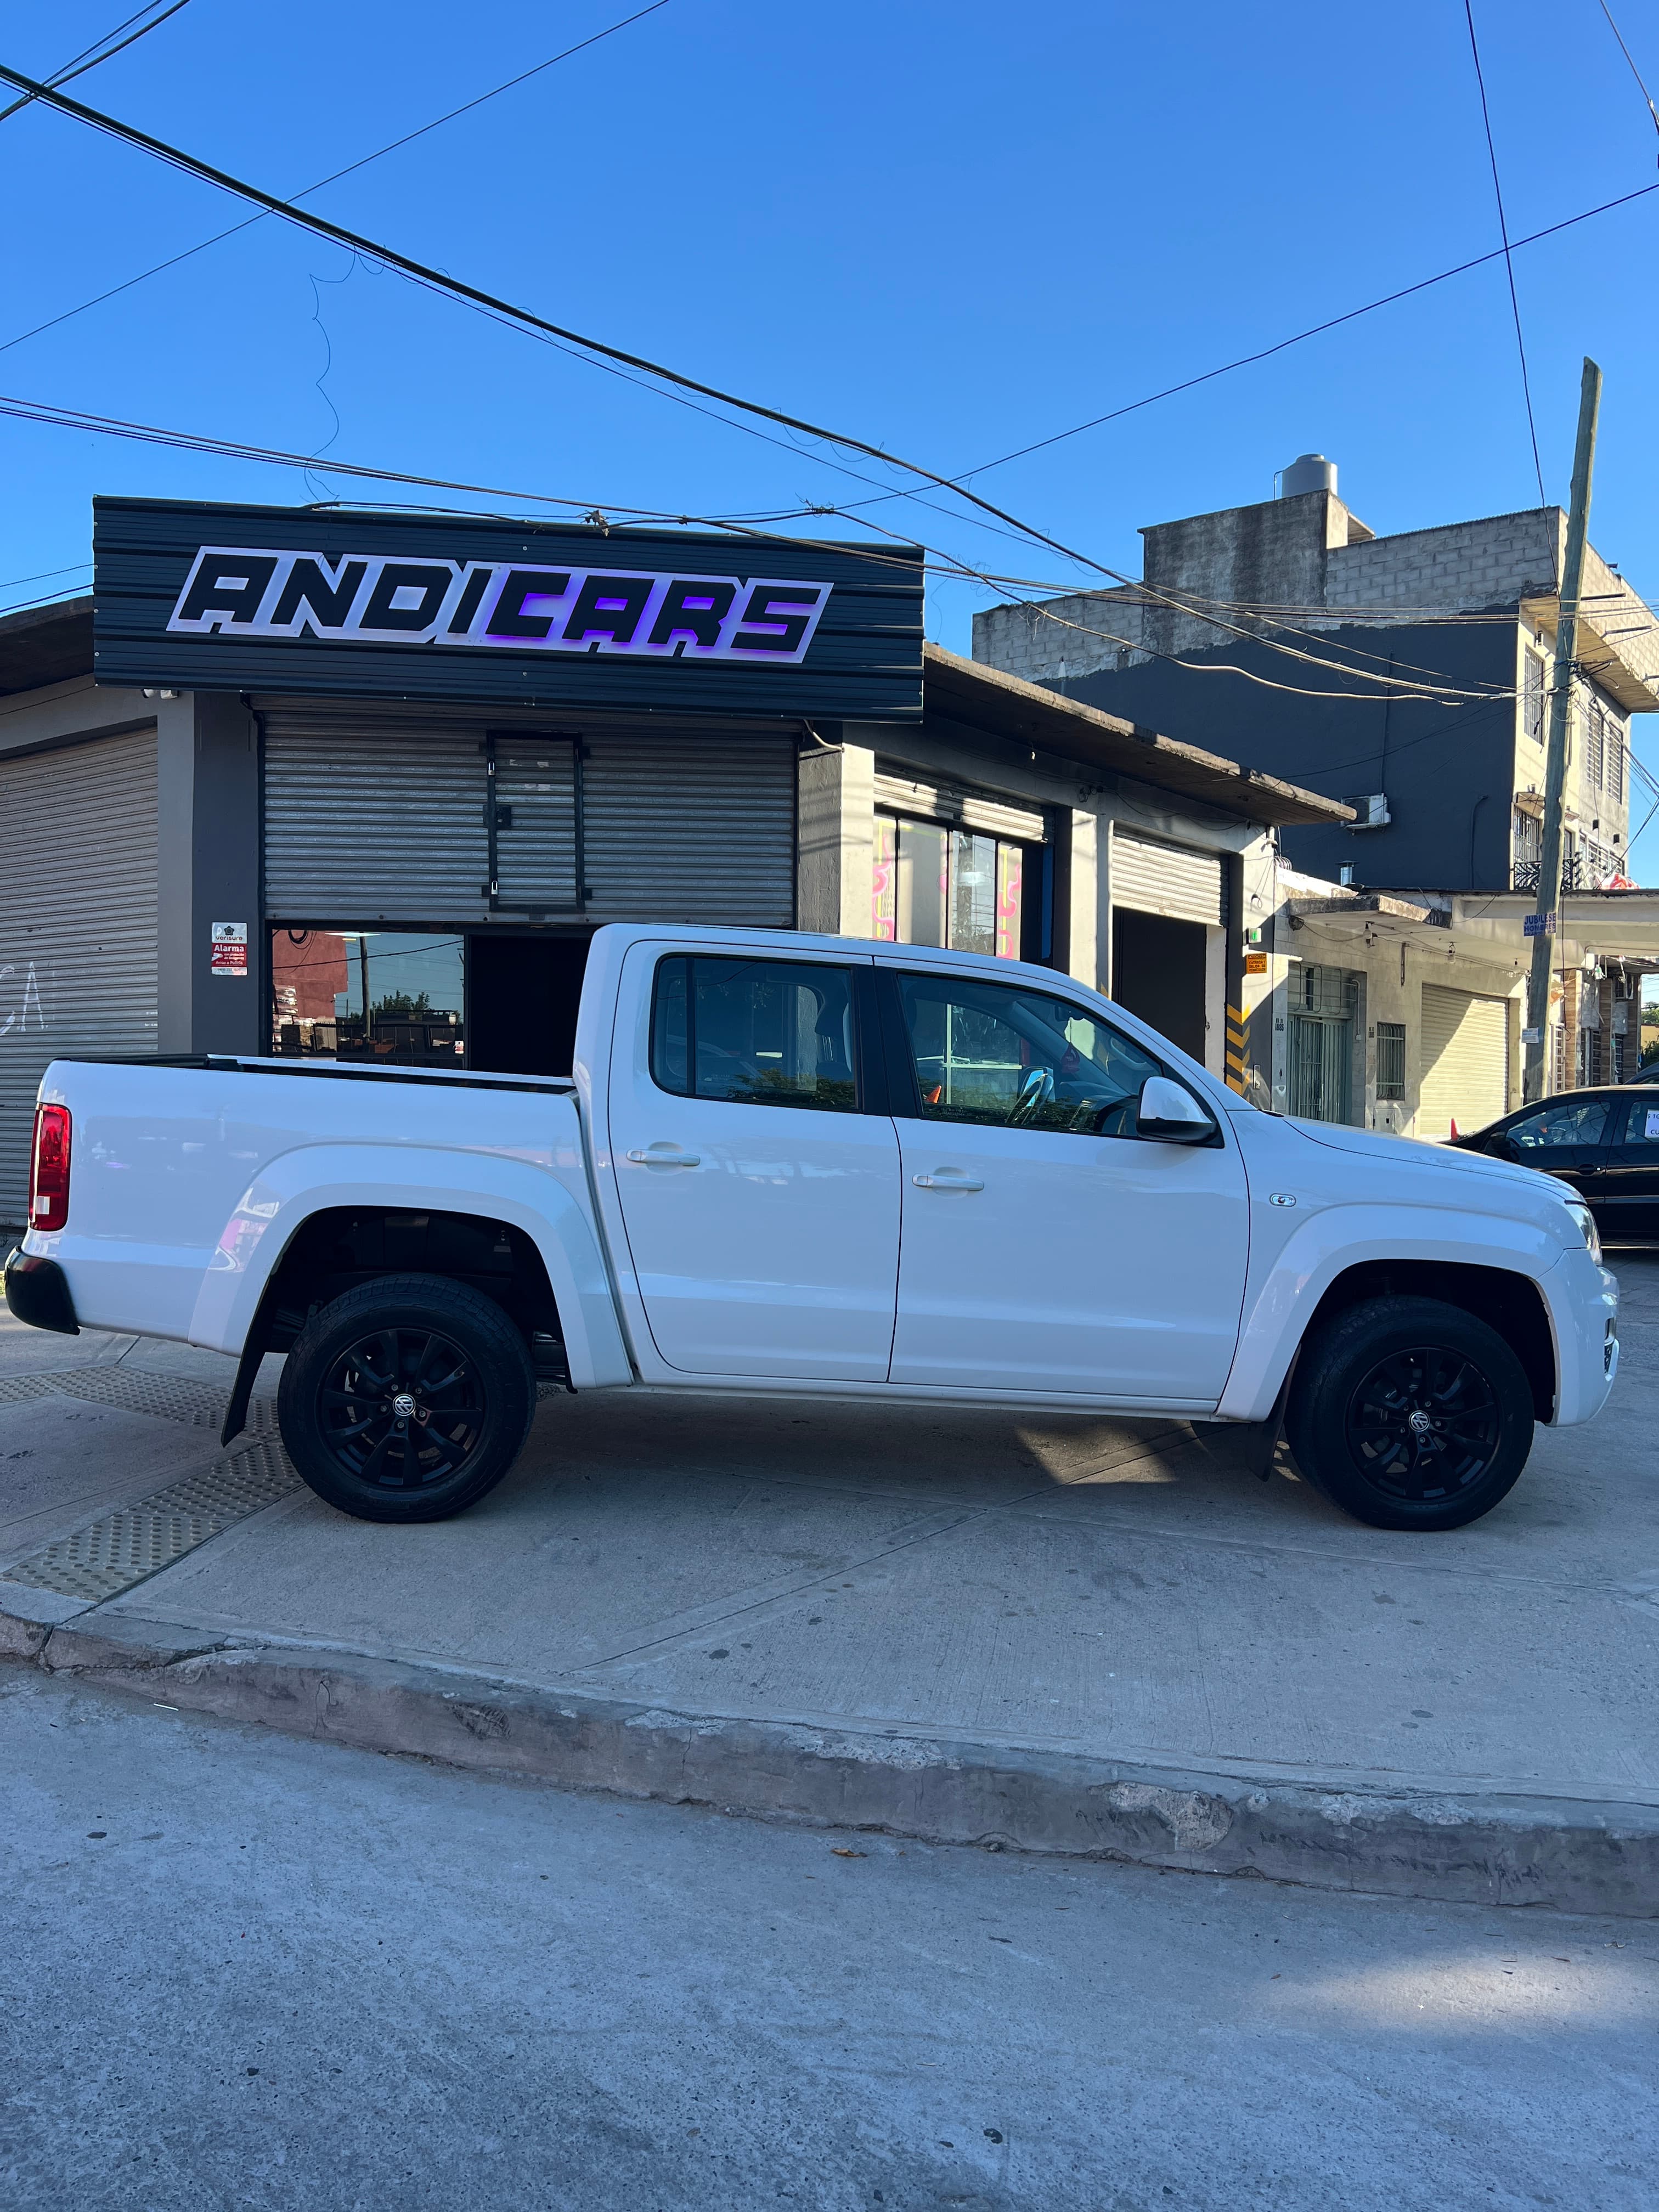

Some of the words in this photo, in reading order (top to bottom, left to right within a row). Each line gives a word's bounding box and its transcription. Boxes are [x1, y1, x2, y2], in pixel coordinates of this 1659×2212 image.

[178, 553, 821, 652] ANDICARS
[1524, 923, 1556, 932] HOMBRES
[214, 944, 245, 952] Alarma
